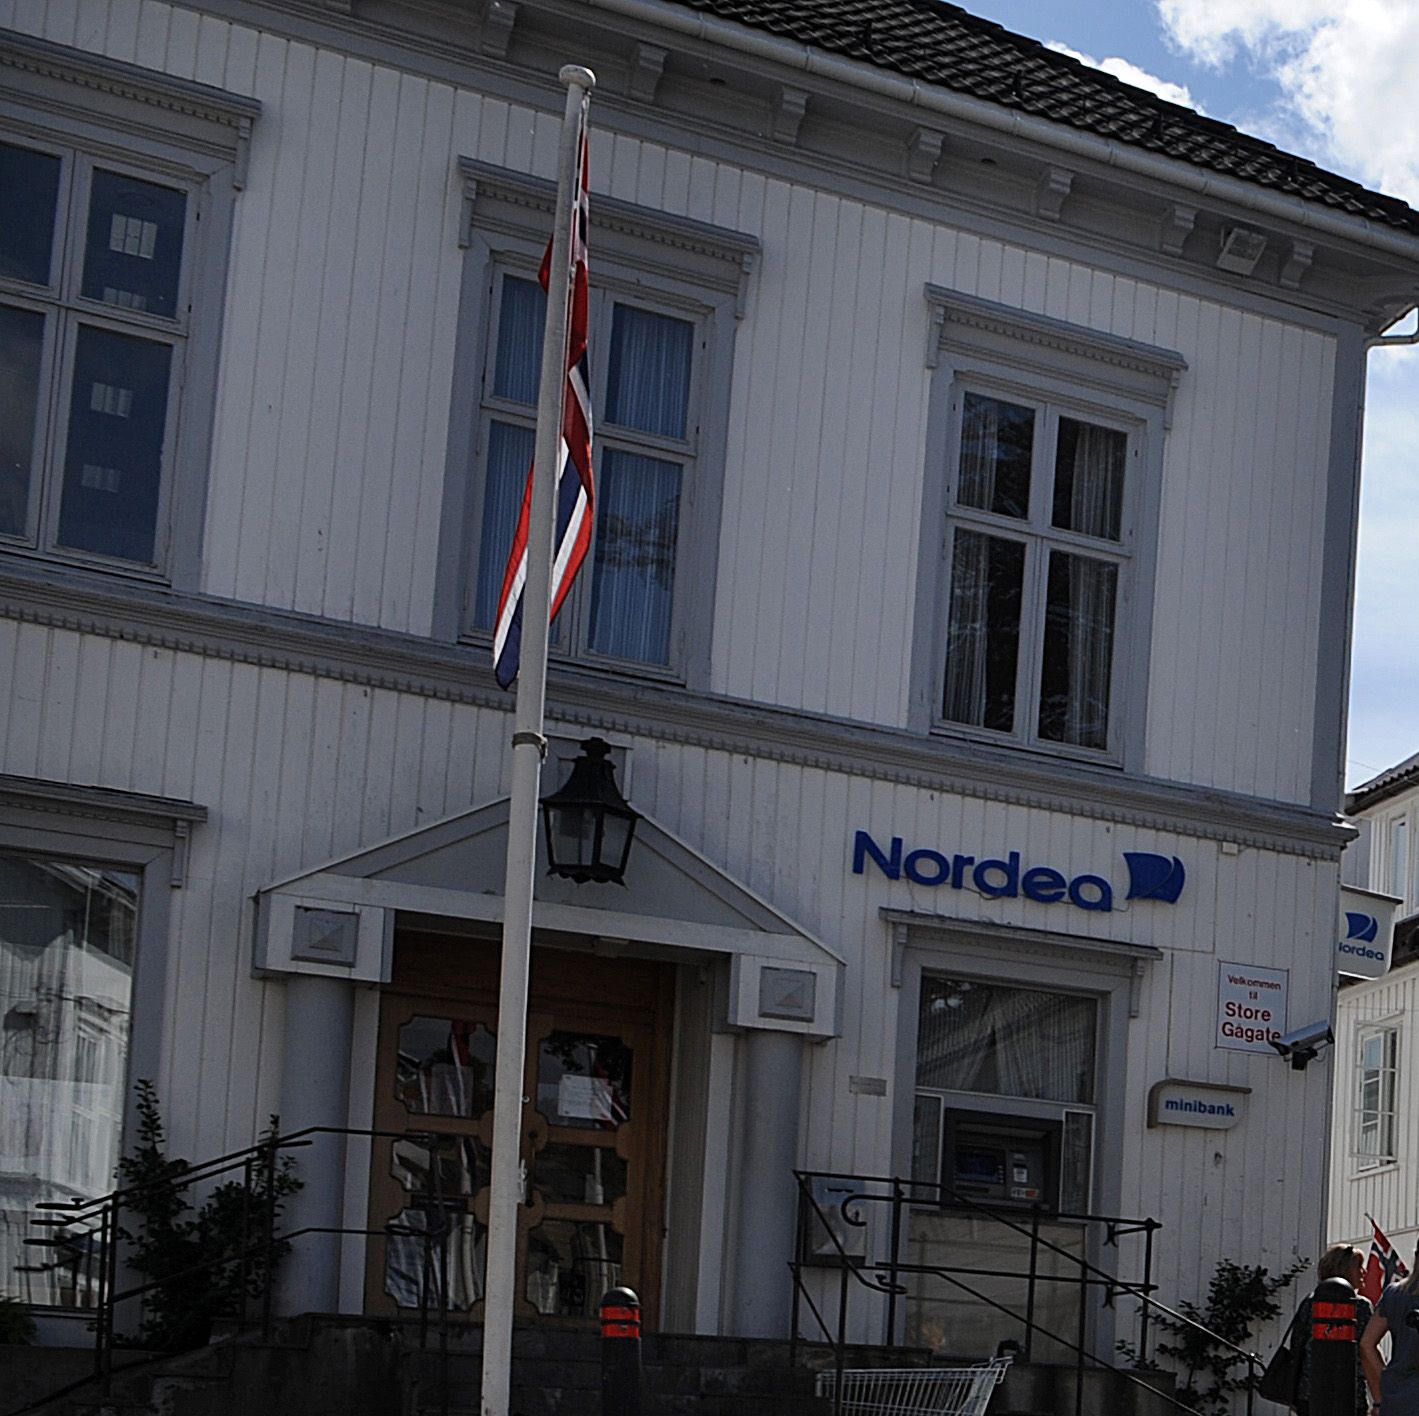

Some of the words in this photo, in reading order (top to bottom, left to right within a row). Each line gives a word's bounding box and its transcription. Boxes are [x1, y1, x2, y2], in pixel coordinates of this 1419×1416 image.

[852, 830, 1112, 912] Nordea
[1227, 974, 1281, 991] Velkommen
[1248, 991, 1258, 1001] til
[1225, 1001, 1271, 1022] Store
[1165, 1098, 1235, 1117] minibank
